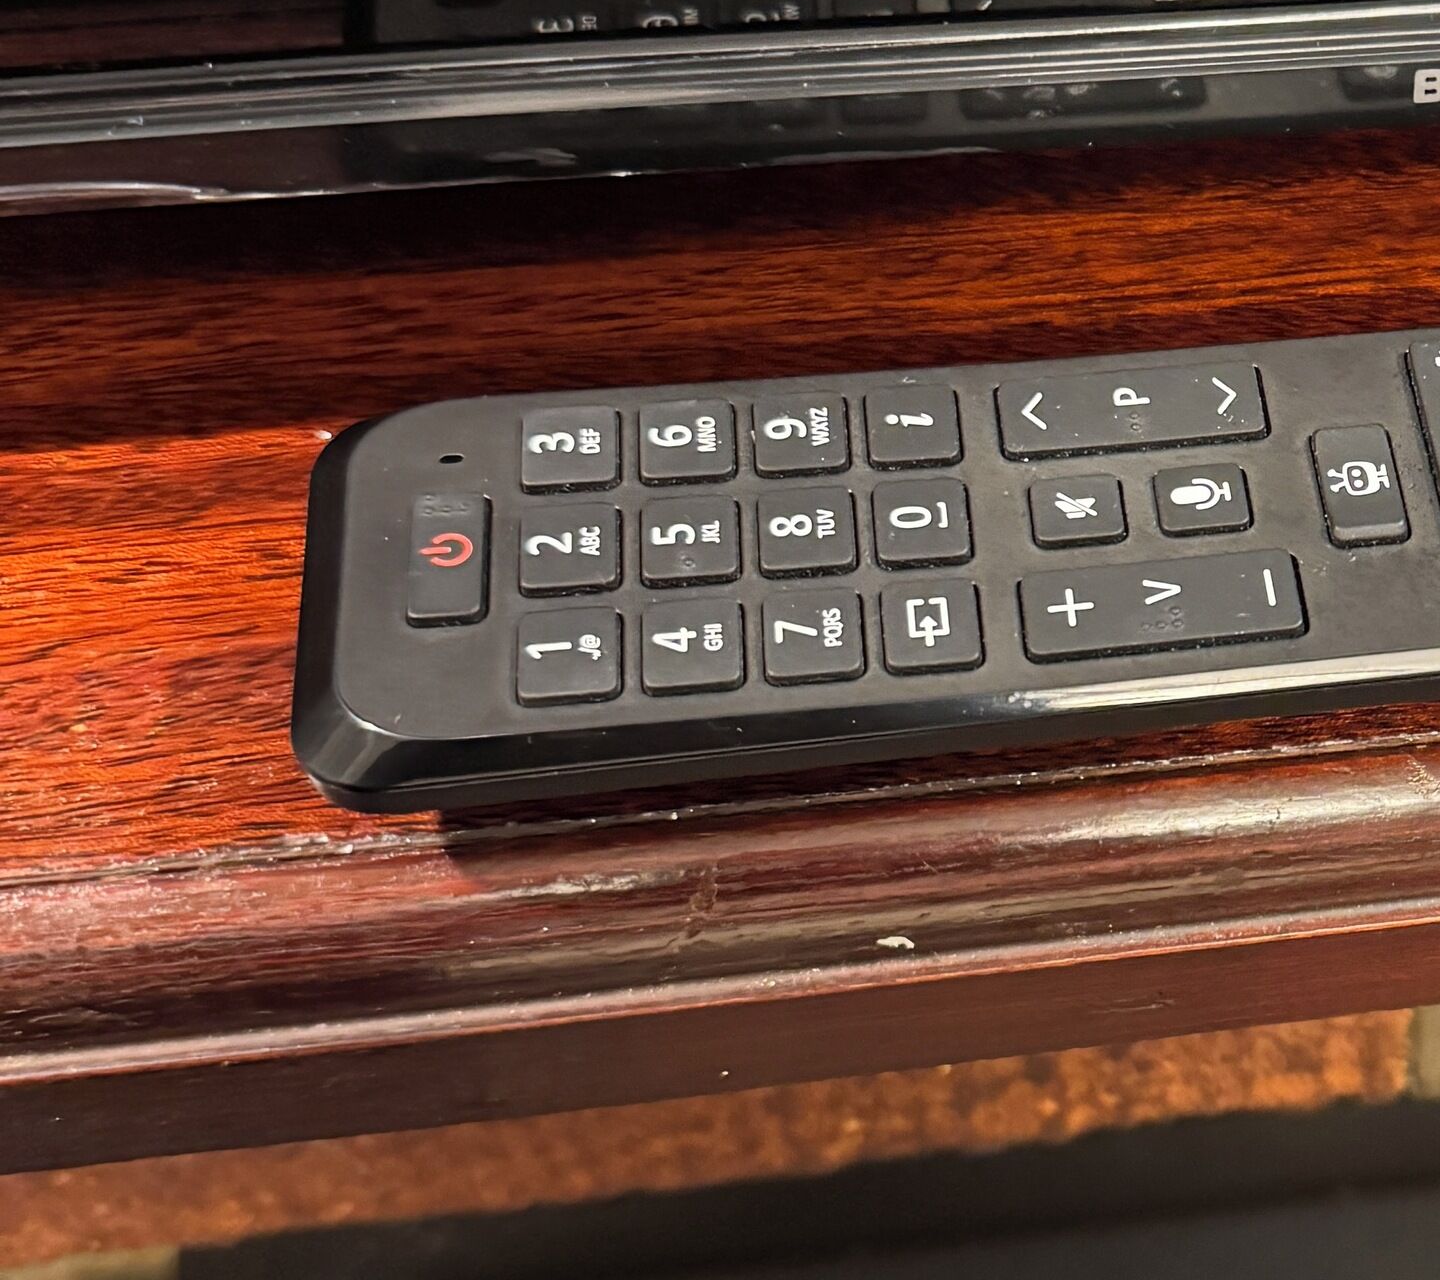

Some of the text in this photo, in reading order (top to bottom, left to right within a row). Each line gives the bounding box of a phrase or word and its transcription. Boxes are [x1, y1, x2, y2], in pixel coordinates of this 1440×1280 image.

[1112, 387, 1151, 407] P
[647, 424, 693, 447] 6
[695, 416, 717, 452] MNO
[763, 415, 807, 440] 9
[808, 406, 830, 447] WXYZ
[527, 431, 575, 454] 3
[578, 428, 601, 454] DEF
[768, 514, 813, 537] 8
[815, 508, 836, 539] TUV
[889, 505, 932, 529] 0
[525, 531, 573, 556] 2
[578, 526, 601, 556] ABC
[650, 523, 696, 546] 5
[700, 519, 721, 544] JKL
[651, 626, 698, 653] 4
[703, 623, 724, 652] GHI
[773, 620, 818, 644] 7
[821, 607, 844, 648] PQRS
[524, 641, 573, 660] 1
